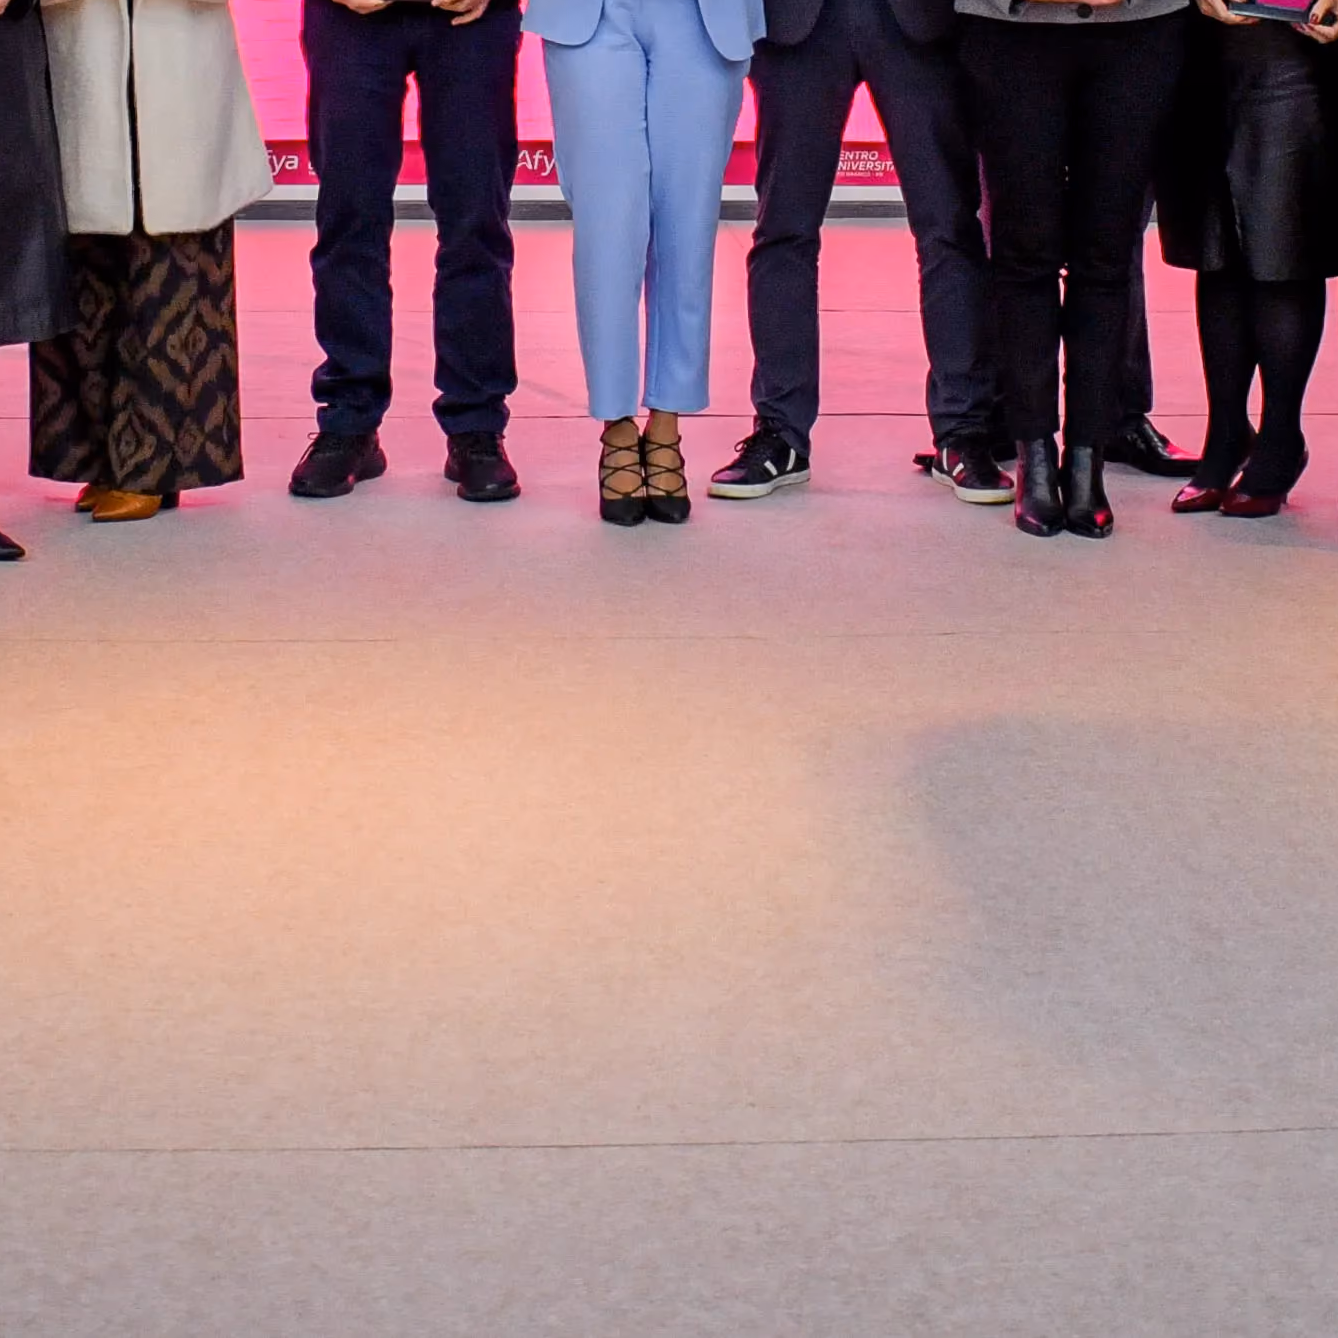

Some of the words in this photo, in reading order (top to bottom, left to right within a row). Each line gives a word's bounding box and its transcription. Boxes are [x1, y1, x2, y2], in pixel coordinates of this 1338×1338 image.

[266, 150, 299, 176] ya
[517, 149, 555, 176] Afy
[839, 150, 879, 160] ENTRO
[838, 161, 895, 171] NIVERSIT
